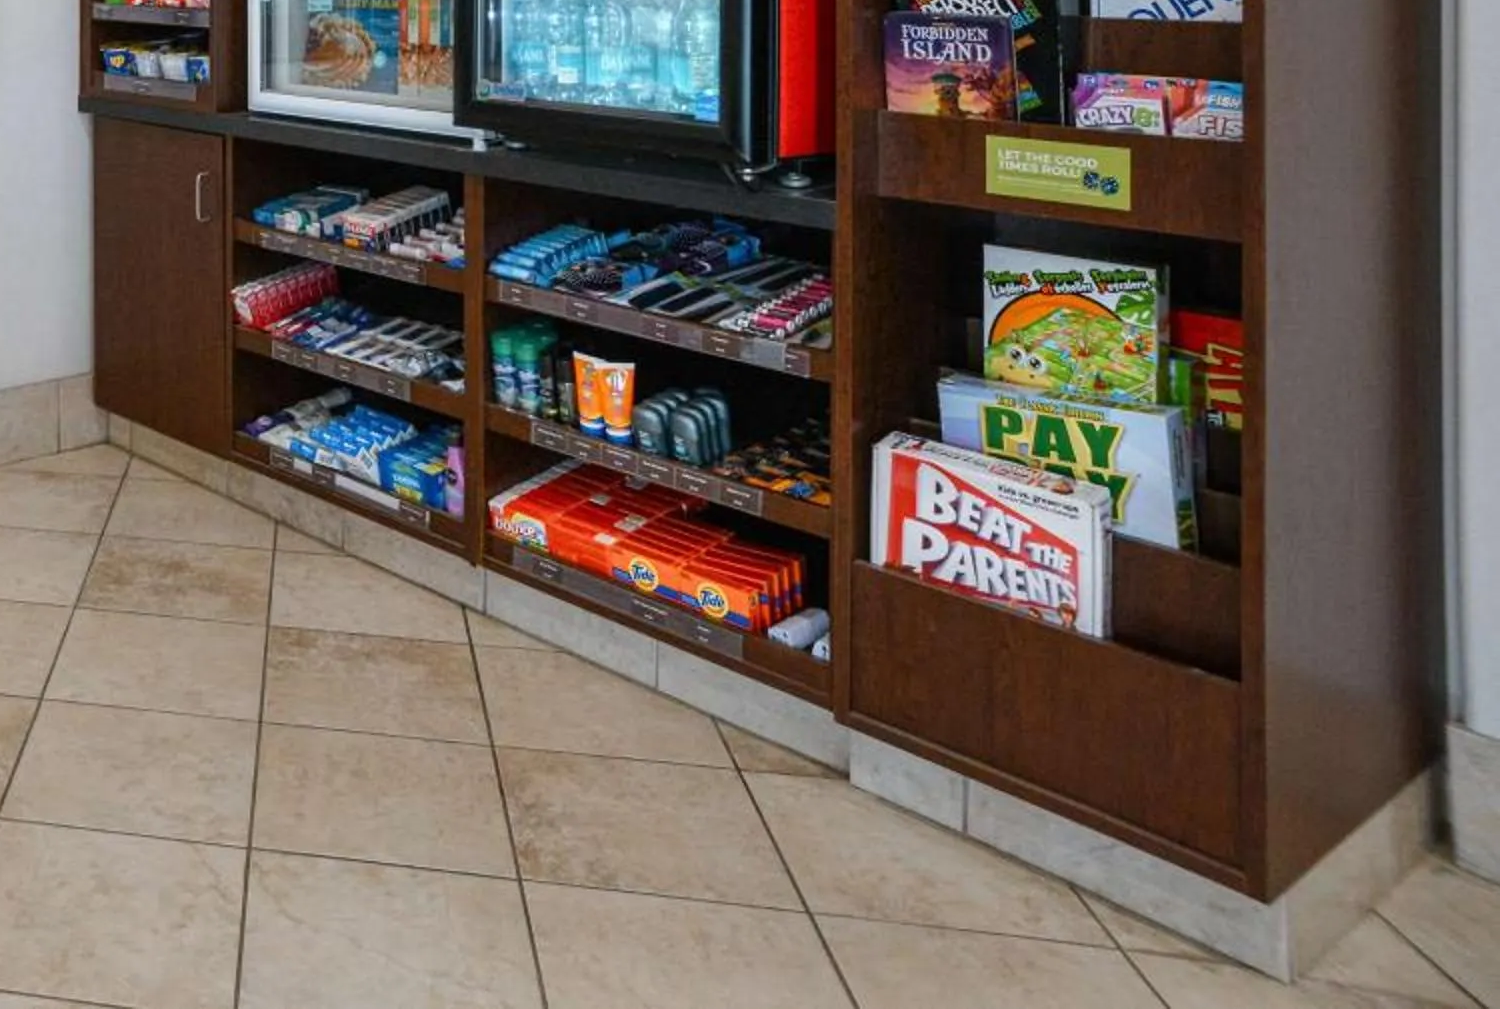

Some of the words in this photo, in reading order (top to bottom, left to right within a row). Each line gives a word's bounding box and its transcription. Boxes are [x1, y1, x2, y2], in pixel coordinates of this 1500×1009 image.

[901, 24, 989, 42] FORBIDDEN
[901, 40, 993, 65] ISLAND
[1078, 105, 1133, 127] CRAZY
[1199, 115, 1243, 139] FIS
[998, 148, 1021, 160] LET
[1025, 151, 1052, 163] THE
[1055, 155, 1099, 169] GOOD
[998, 159, 1039, 174] TIMES
[983, 405, 1121, 470] PAY
[917, 462, 1033, 553] BEAT
[1026, 542, 1072, 572] THE
[631, 563, 656, 583] Tide
[902, 518, 1077, 609] PARENTS
[699, 589, 725, 608] Tide
